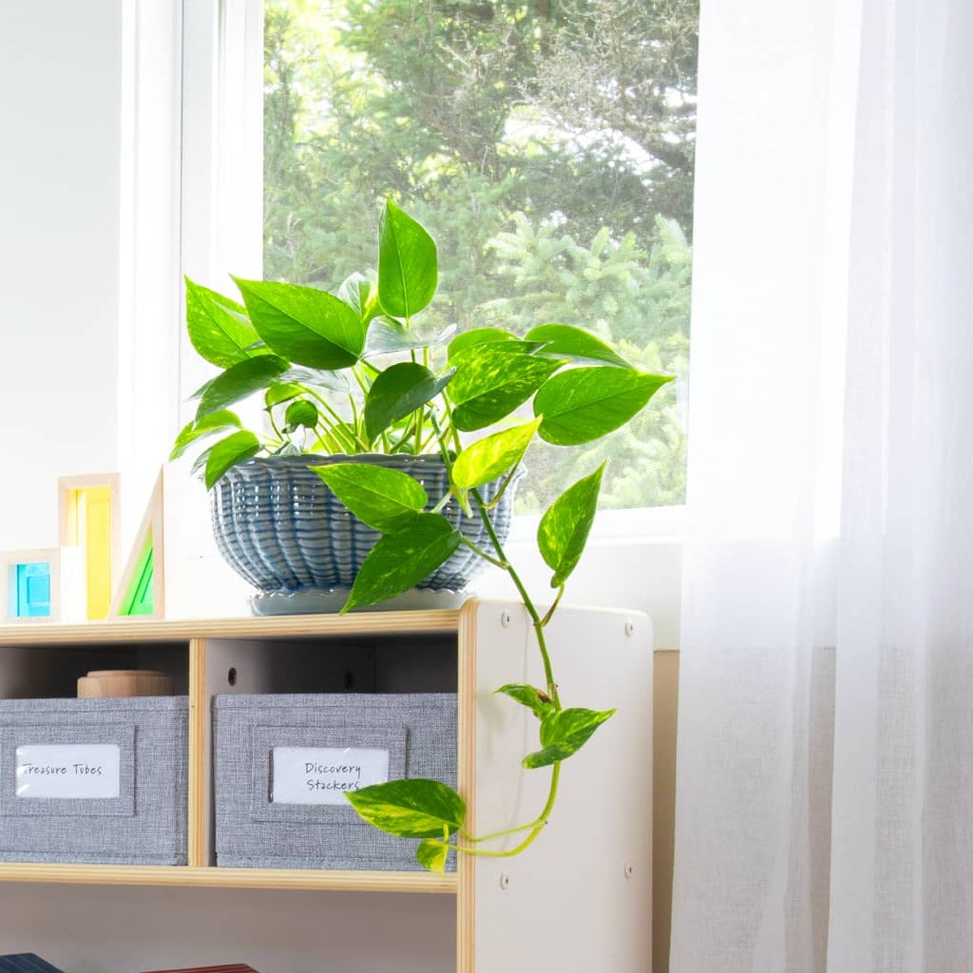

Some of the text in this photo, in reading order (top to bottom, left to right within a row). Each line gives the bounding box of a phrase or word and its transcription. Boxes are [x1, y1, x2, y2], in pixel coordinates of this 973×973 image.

[22, 763, 67, 775] Treasure
[305, 762, 361, 779] Discovery
[306, 779, 360, 791] Stackers
